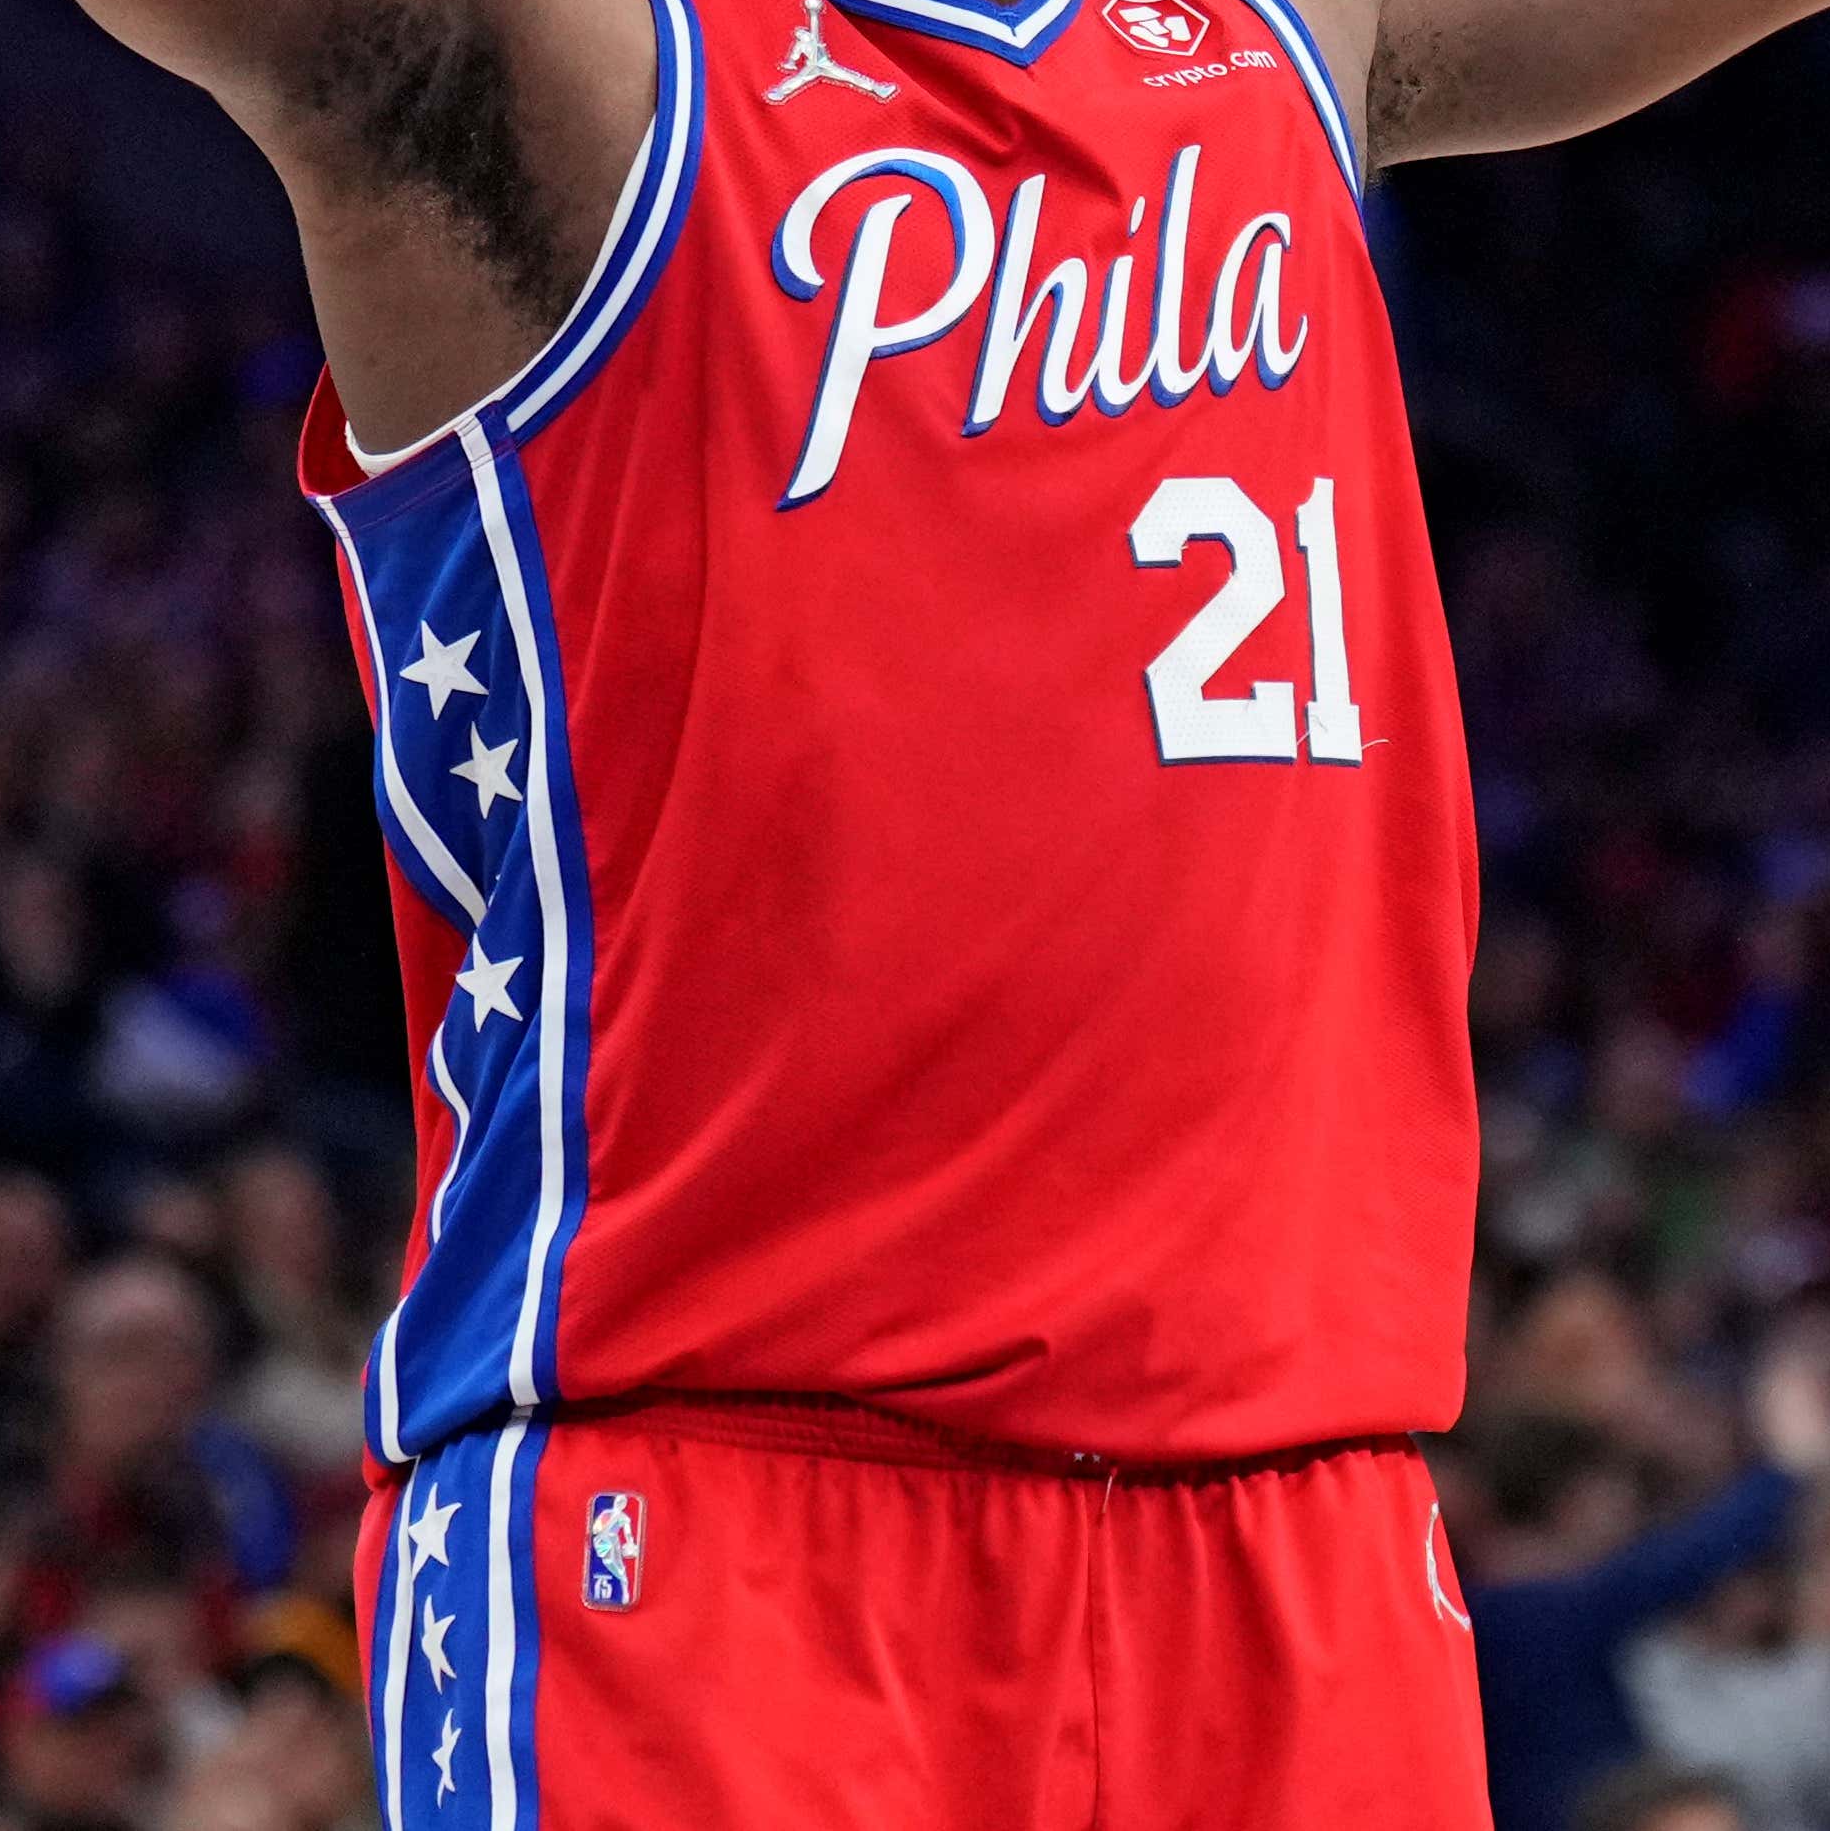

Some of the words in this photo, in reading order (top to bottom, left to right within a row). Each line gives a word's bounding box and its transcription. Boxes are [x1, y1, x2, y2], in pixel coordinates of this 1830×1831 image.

[1143, 49, 1278, 87] crypto.com
[772, 146, 1309, 512] Phila
[1128, 476, 1364, 768] 21
[593, 1573, 614, 1600] 75
